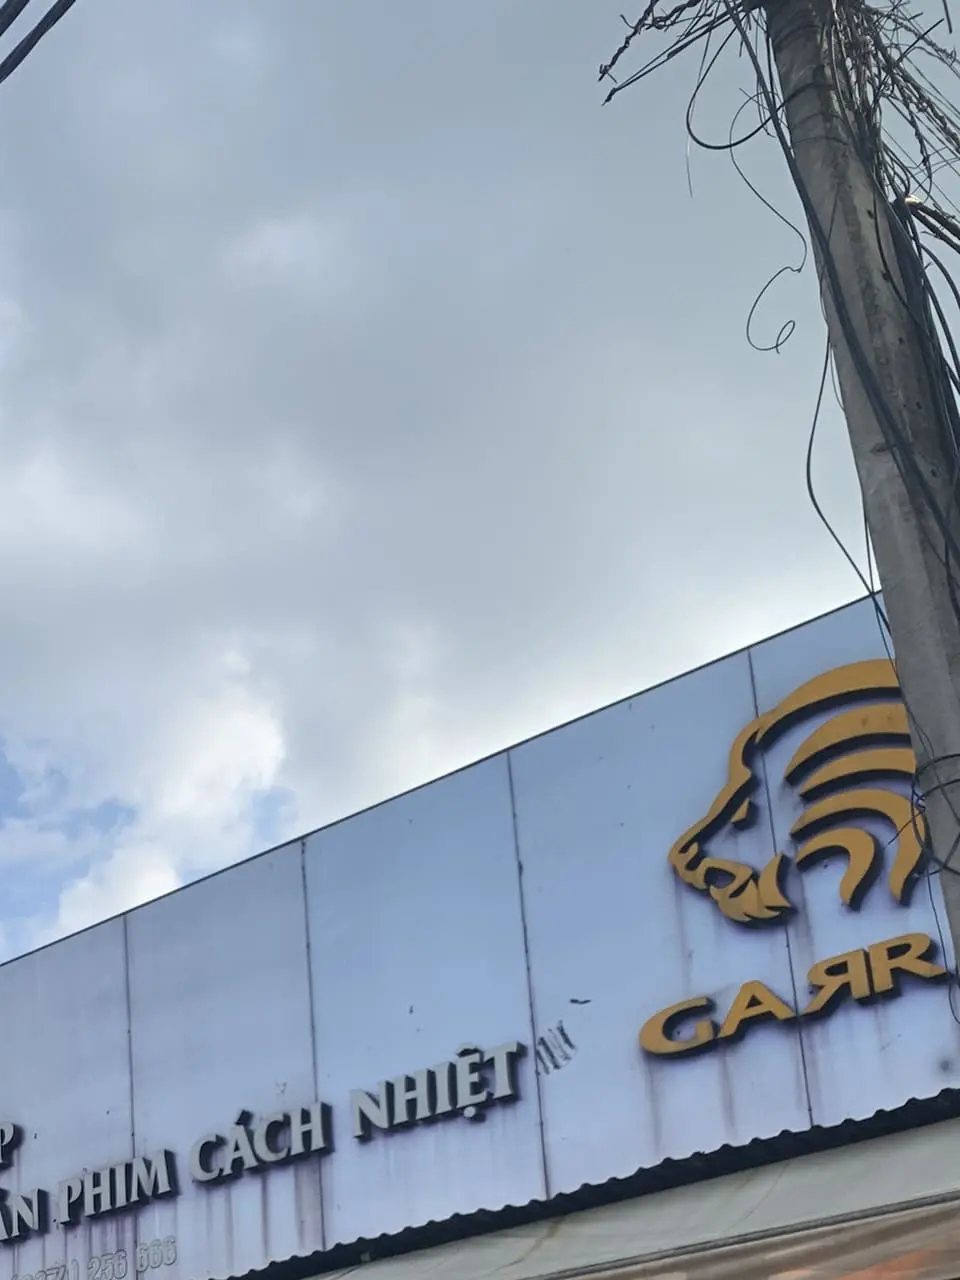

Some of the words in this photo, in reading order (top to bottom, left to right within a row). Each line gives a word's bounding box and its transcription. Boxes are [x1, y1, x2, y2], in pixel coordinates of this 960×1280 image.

[53, 1149, 173, 1226] PHIM
[189, 1101, 328, 1183] CÁCH
[350, 1041, 526, 1141] NHIỆT
